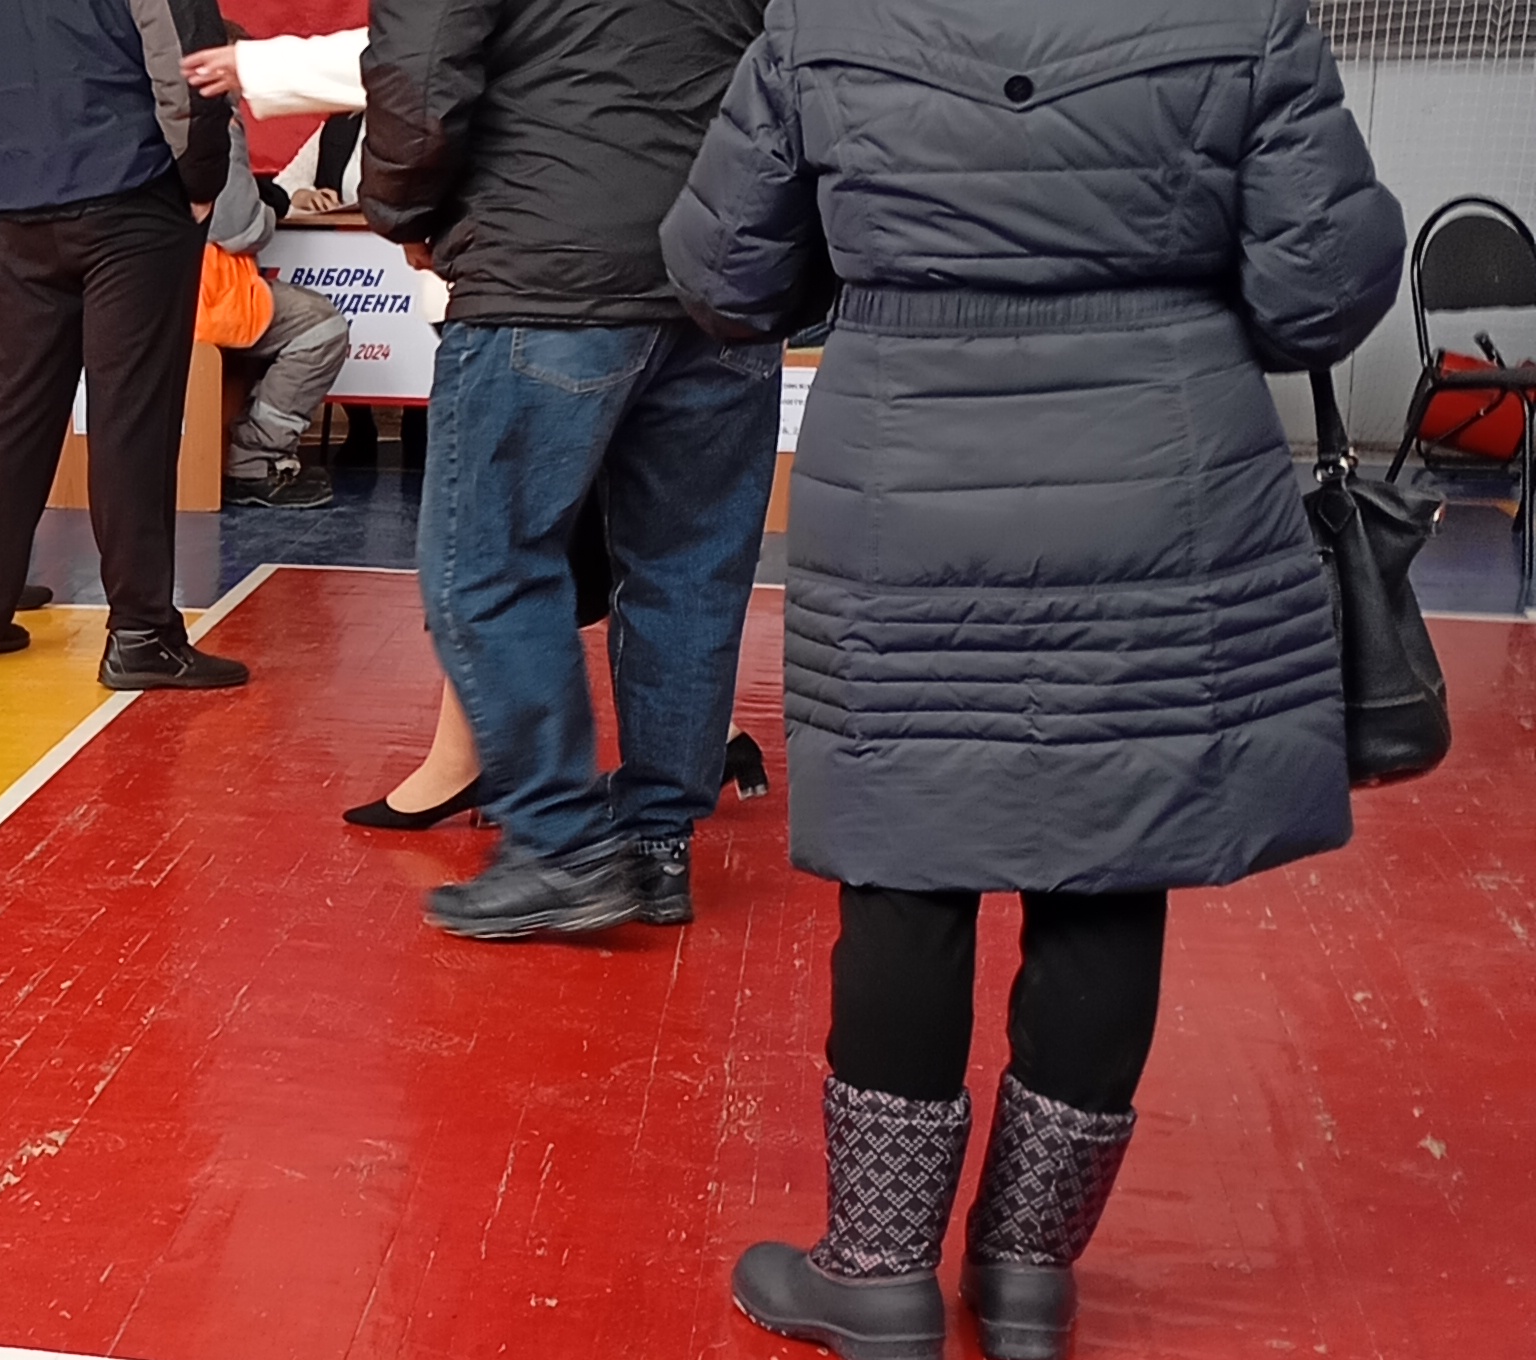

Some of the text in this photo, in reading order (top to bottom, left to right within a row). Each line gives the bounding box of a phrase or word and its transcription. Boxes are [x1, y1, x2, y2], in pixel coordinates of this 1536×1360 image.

[290, 267, 384, 287] ВЫБОРЫ
[330, 294, 411, 314] ИДЕНТА
[354, 344, 391, 361] 2024
